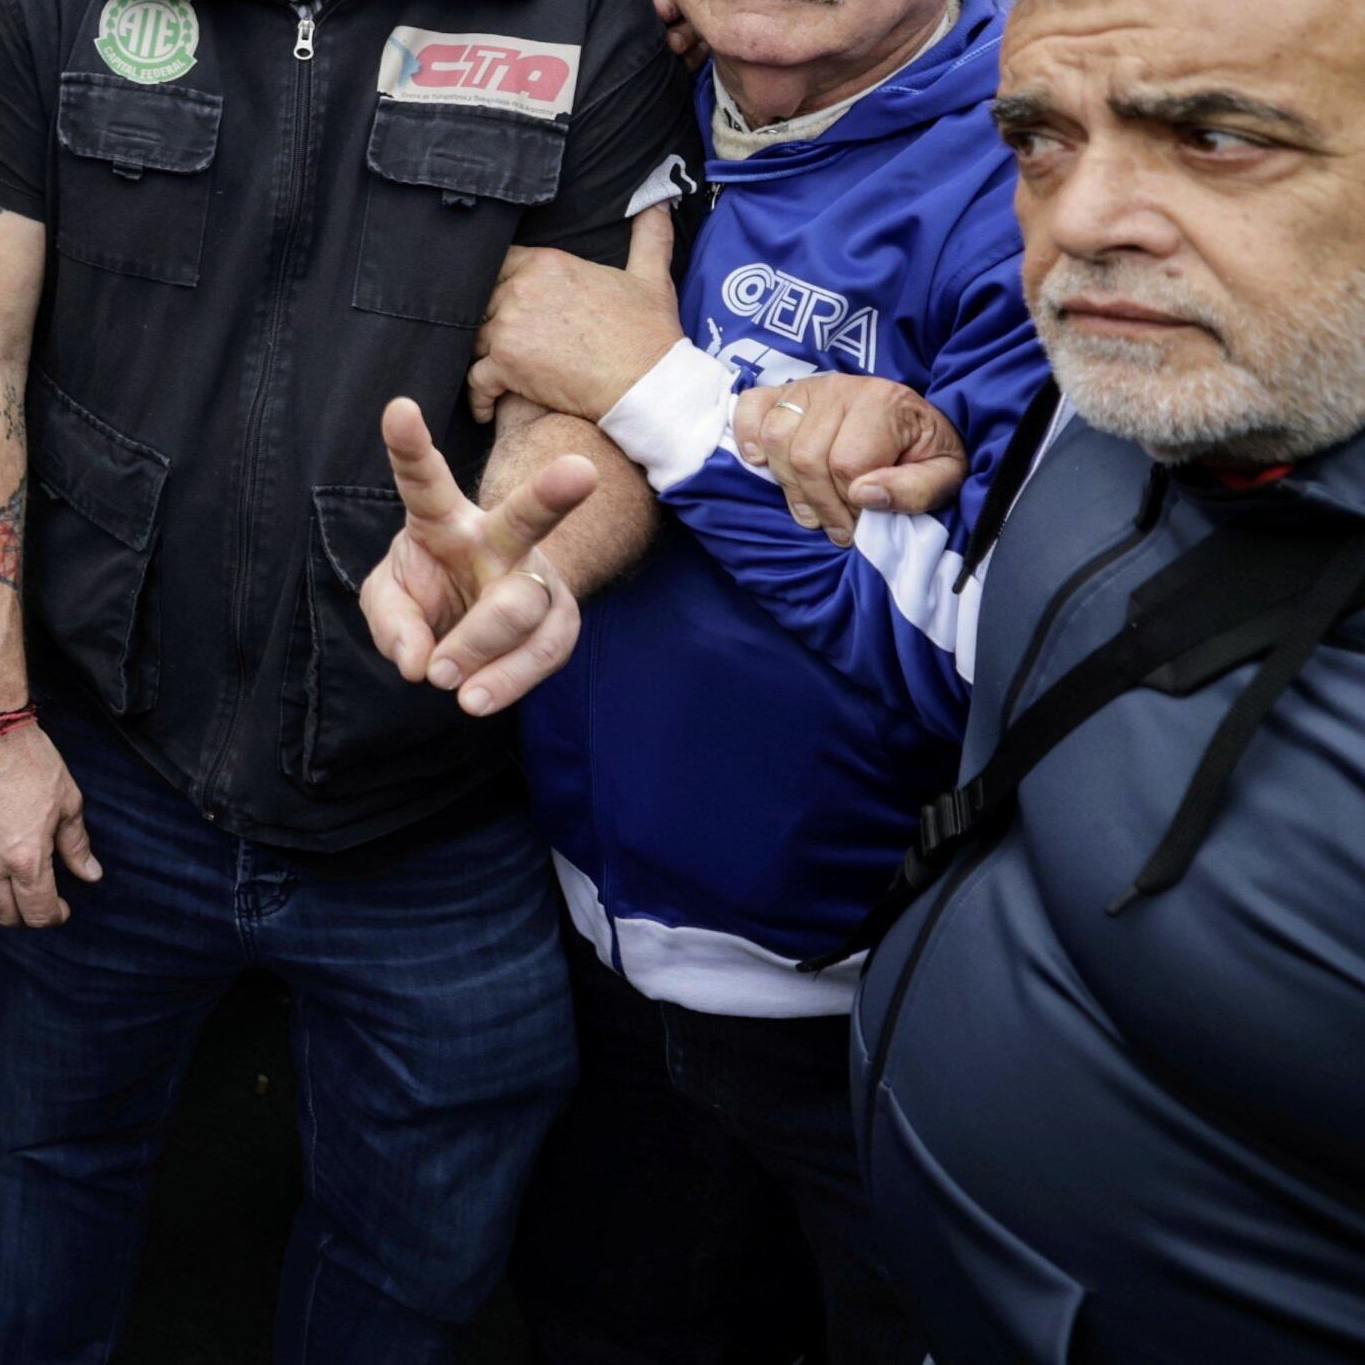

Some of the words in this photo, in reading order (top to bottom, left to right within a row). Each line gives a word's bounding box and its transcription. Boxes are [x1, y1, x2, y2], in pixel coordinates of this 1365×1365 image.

[117, 0, 177, 59] ATE
[104, 45, 137, 77] CAPITAL
[139, 58, 187, 79] FEDERAL
[409, 42, 571, 102] CTA
[721, 261, 878, 374] CTERA
